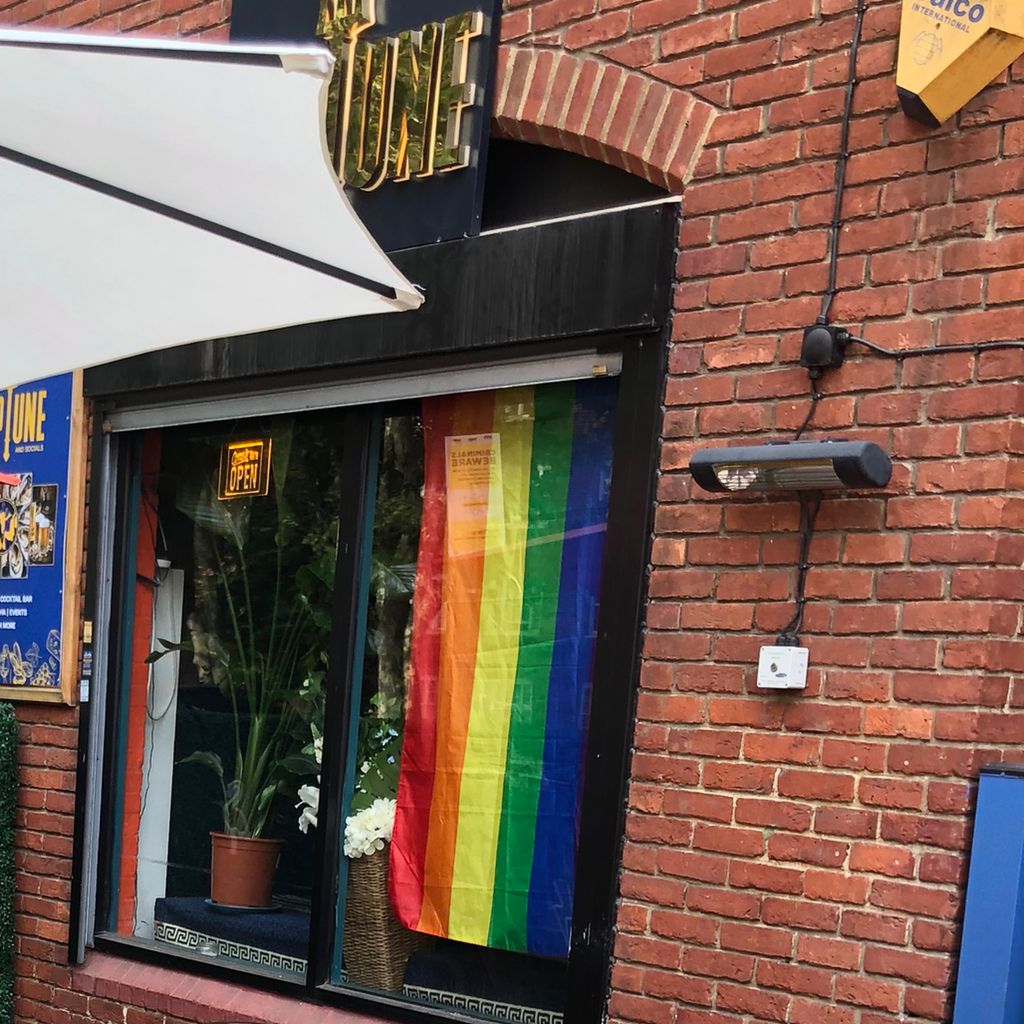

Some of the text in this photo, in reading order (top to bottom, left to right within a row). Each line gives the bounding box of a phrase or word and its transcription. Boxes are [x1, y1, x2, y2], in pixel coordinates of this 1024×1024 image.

[911, 3, 971, 33] INTERNATIONAL
[230, 463, 258, 491] OPEN
[0, 595, 22, 603] COCKTAIL
[22, 595, 33, 603] BAR
[9, 608, 28, 616] EVENTS
[3, 621, 16, 630] MORE
